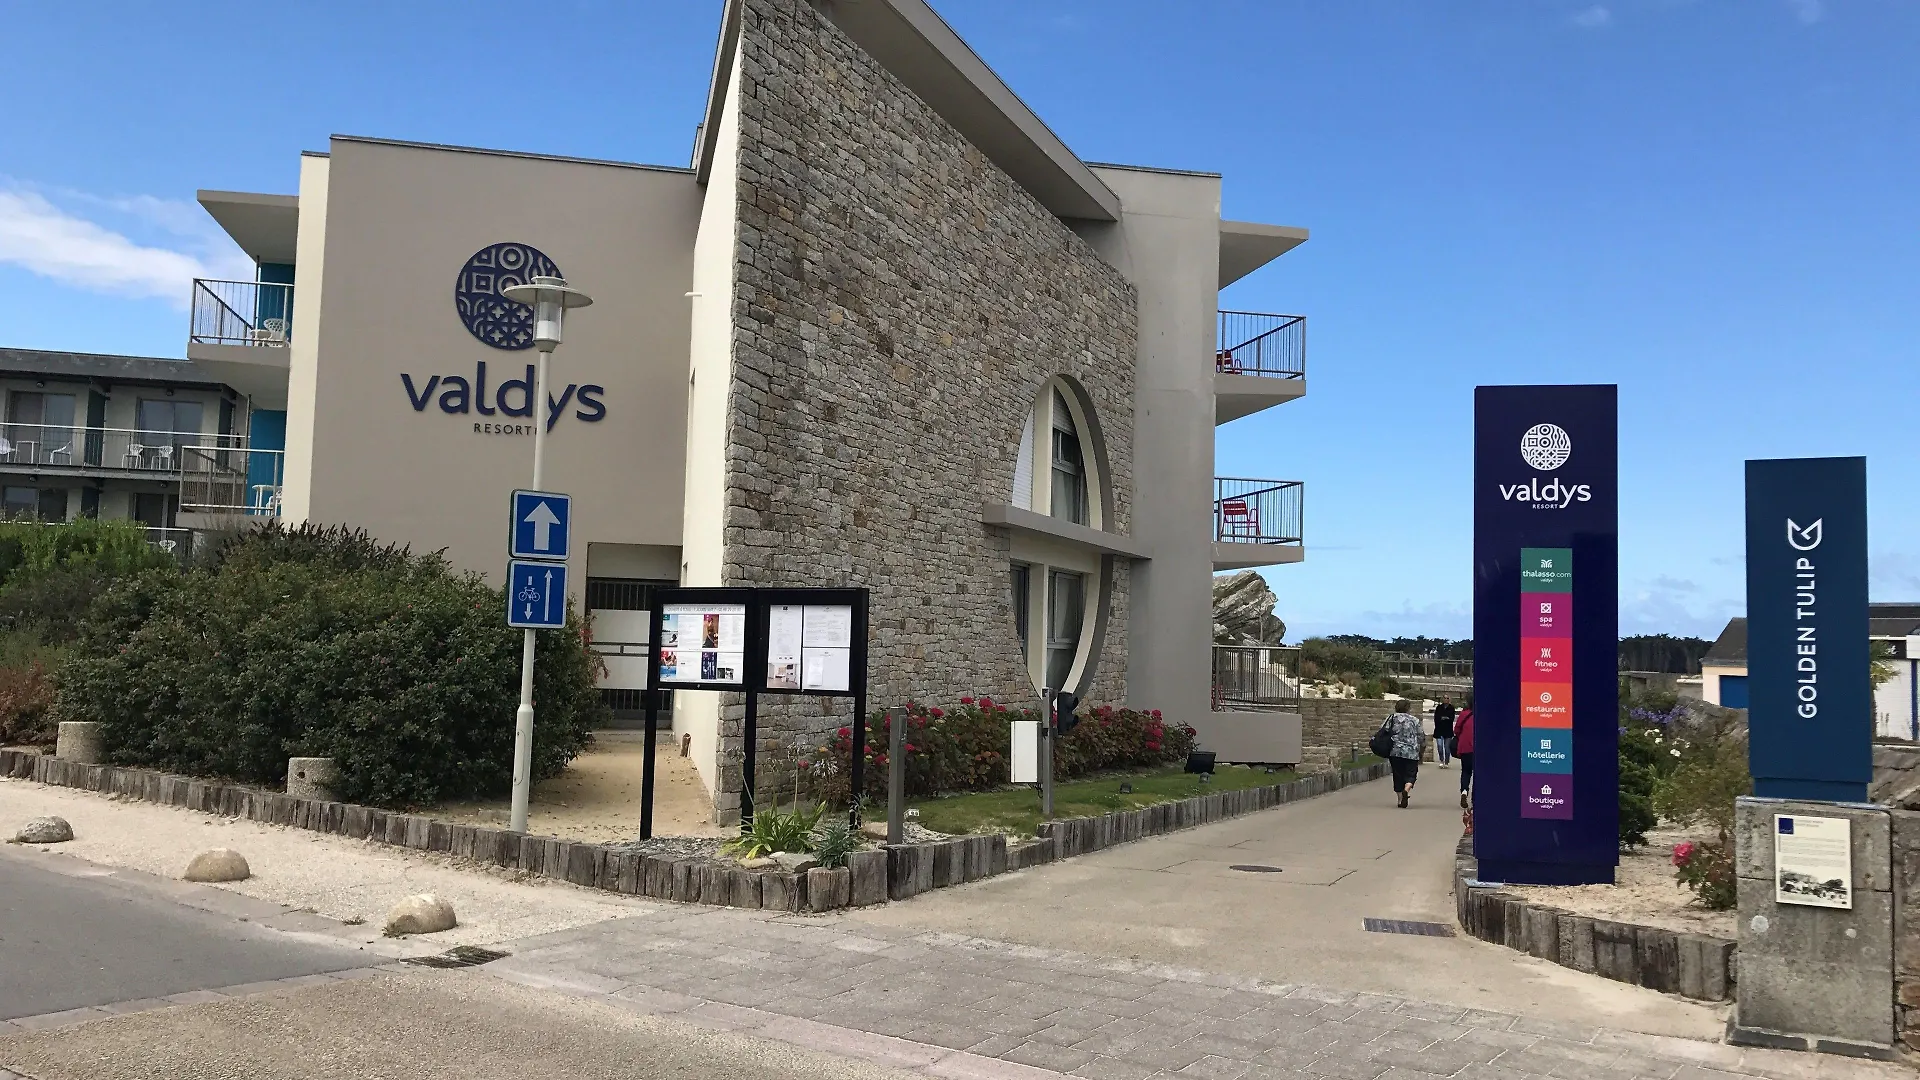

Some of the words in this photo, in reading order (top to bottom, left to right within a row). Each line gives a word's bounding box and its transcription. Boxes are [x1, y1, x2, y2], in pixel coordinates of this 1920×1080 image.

[400, 360, 606, 434] valdys
[474, 423, 531, 436] RESORT
[1499, 477, 1592, 509] valdys
[1522, 570, 1572, 578] thalasso.com
[1796, 557, 1816, 620] TULIP
[1534, 659, 1558, 667] fitneo
[1797, 627, 1818, 719] GOLDEN
[1526, 705, 1567, 713] restaurant
[1527, 751, 1566, 759] hôtellerie
[1529, 796, 1564, 806] boutique
